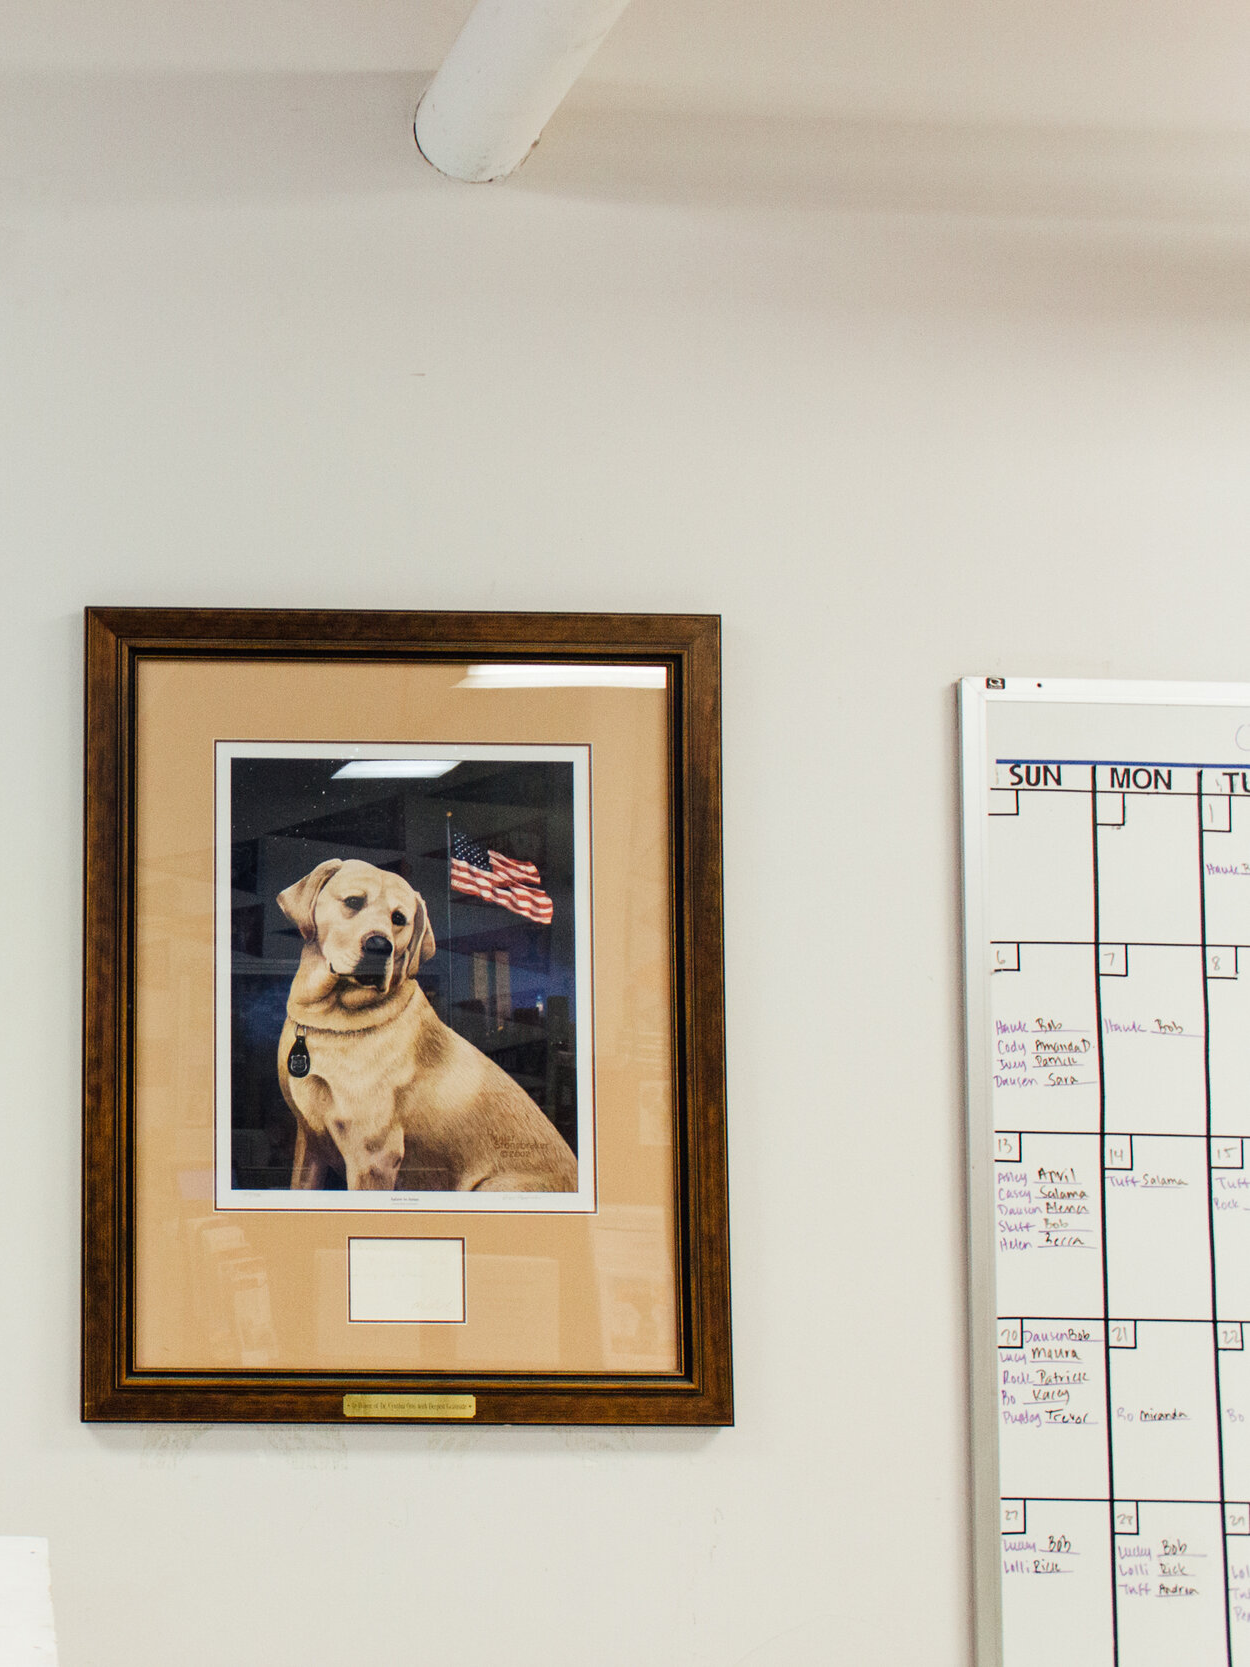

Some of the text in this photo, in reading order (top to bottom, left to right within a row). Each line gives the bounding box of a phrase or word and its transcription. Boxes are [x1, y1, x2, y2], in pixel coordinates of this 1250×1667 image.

[1009, 764, 1062, 787] SUN
[1110, 767, 1172, 790] MON
[996, 950, 1006, 964] 6
[1103, 952, 1115, 966] 7
[1211, 955, 1221, 971] 8
[997, 1039, 1027, 1056] Cody
[1048, 1072, 1079, 1087] Sara
[997, 1138, 1013, 1153] 13
[1109, 1148, 1124, 1165] 14
[1217, 1147, 1237, 1160] 15
[1037, 1167, 1077, 1184] April
[1142, 1173, 1189, 1186] Salama
[1005, 1509, 1019, 1521] 27
[1161, 1538, 1188, 1556] Bob
[1159, 1562, 1189, 1576] Rick
